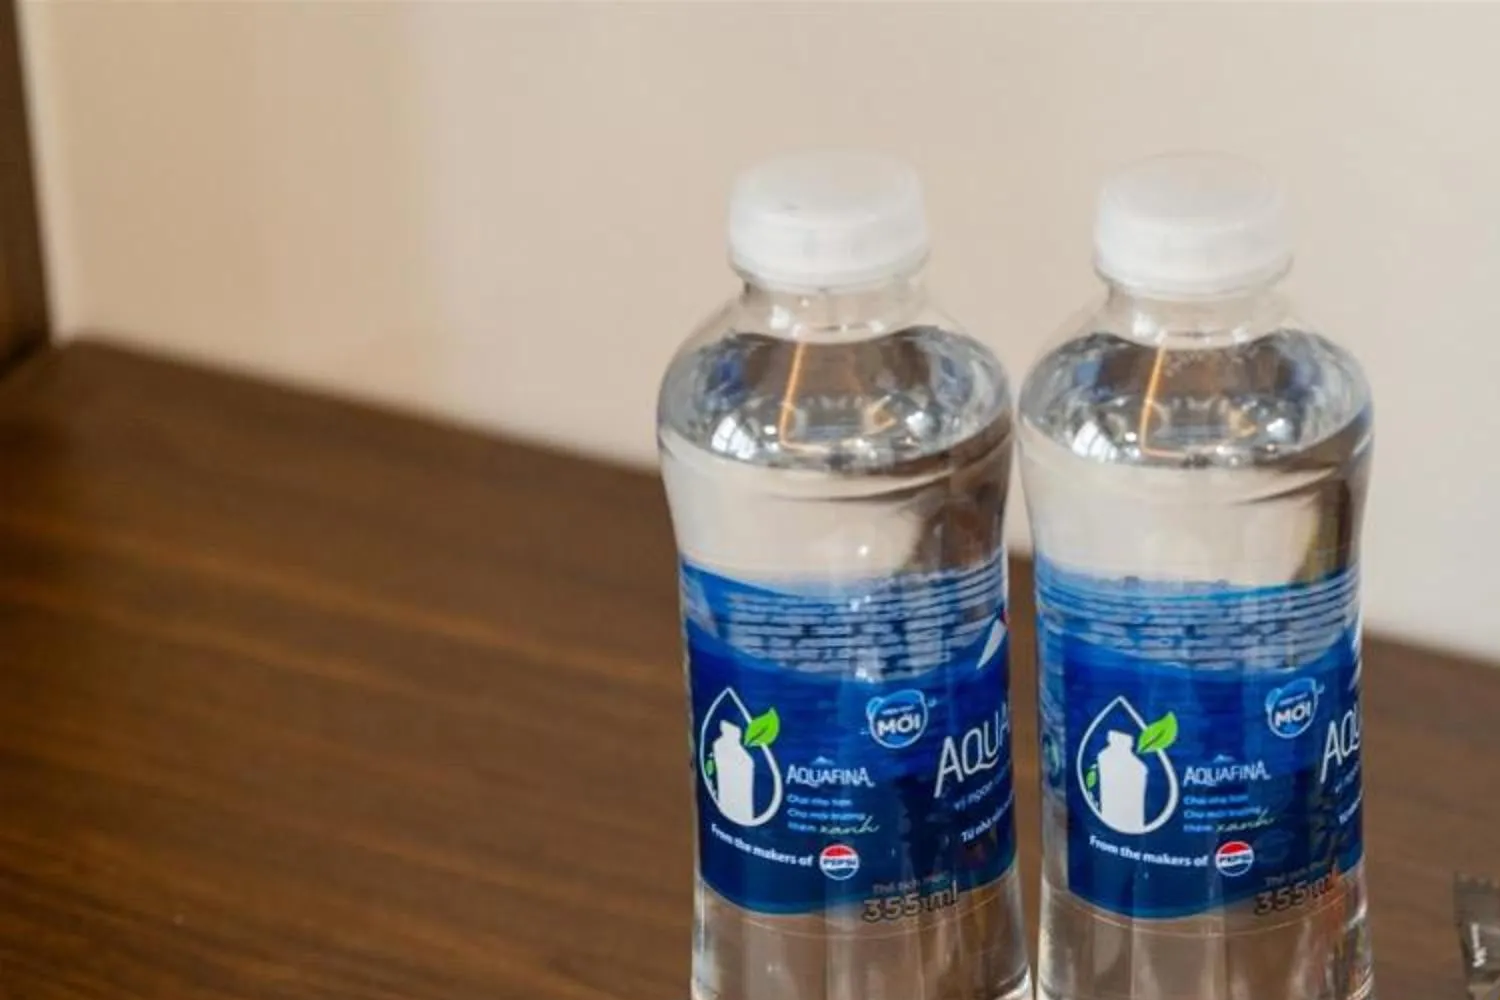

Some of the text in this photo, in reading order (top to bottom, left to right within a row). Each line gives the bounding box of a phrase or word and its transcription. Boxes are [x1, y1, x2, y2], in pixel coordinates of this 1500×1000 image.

[785, 764, 876, 788] AQUAFINA
[1182, 760, 1272, 788] AQUAFINA
[711, 823, 814, 867] From the makers of
[1089, 835, 1118, 855] From
[1119, 846, 1141, 861] the
[1143, 852, 1191, 868] makers
[1193, 855, 1209, 867] of
[862, 892, 920, 923] 355
[1254, 880, 1307, 915] 355
